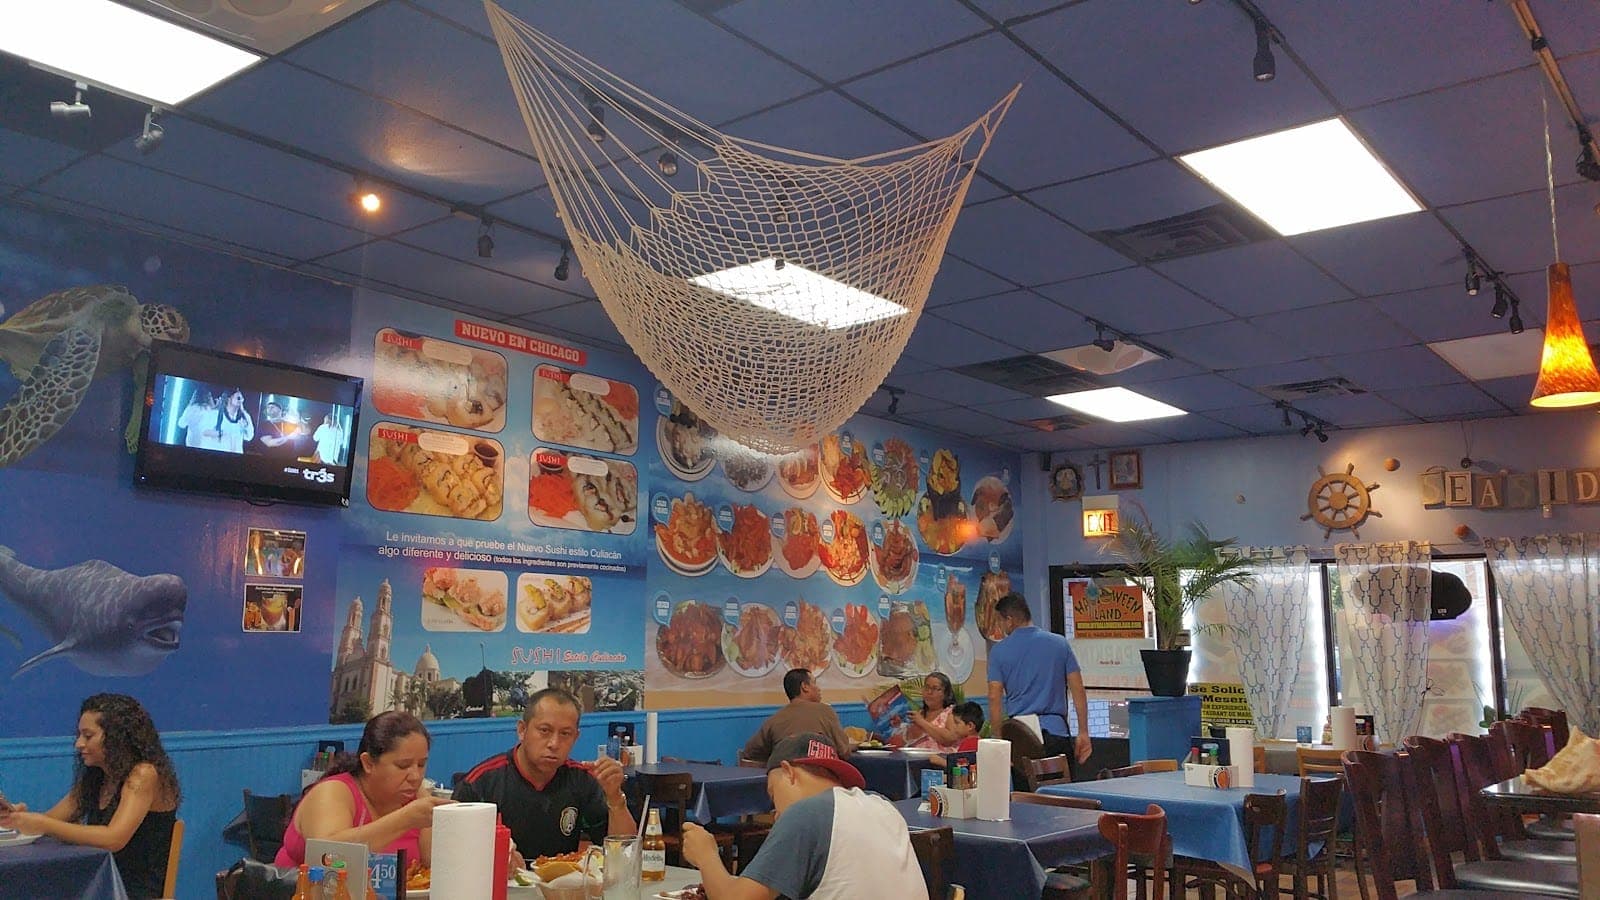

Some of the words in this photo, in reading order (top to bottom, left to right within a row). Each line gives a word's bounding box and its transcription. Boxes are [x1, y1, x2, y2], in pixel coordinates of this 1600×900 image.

[462, 323, 505, 343] NUEVO
[508, 333, 527, 349] EN
[529, 340, 580, 362] CHICAGO
[382, 429, 408, 441] SUSHI
[539, 454, 560, 464] SUSHI
[1087, 512, 1114, 532] EXIT
[386, 531, 399, 542] Le
[401, 532, 446, 546] invitamos
[448, 538, 455, 546] a
[456, 538, 473, 549] que
[475, 539, 505, 551] pruebe
[507, 540, 516, 550] el
[517, 541, 543, 553] Nuevo
[545, 544, 568, 555] Sushi
[568, 546, 589, 557] estilo
[590, 548, 622, 560] Culiacán
[378, 545, 400, 557] algo
[402, 546, 444, 559] diferente
[446, 551, 452, 561] y
[454, 550, 492, 562] delicioso
[493, 555, 512, 564] (todos
[512, 556, 522, 565] los
[522, 557, 556, 567] ingredientes
[1094, 607, 1122, 620] LAND
[511, 646, 561, 665] SUSHI
[1190, 685, 1207, 693] Se
[1211, 685, 1245, 694] Solic
